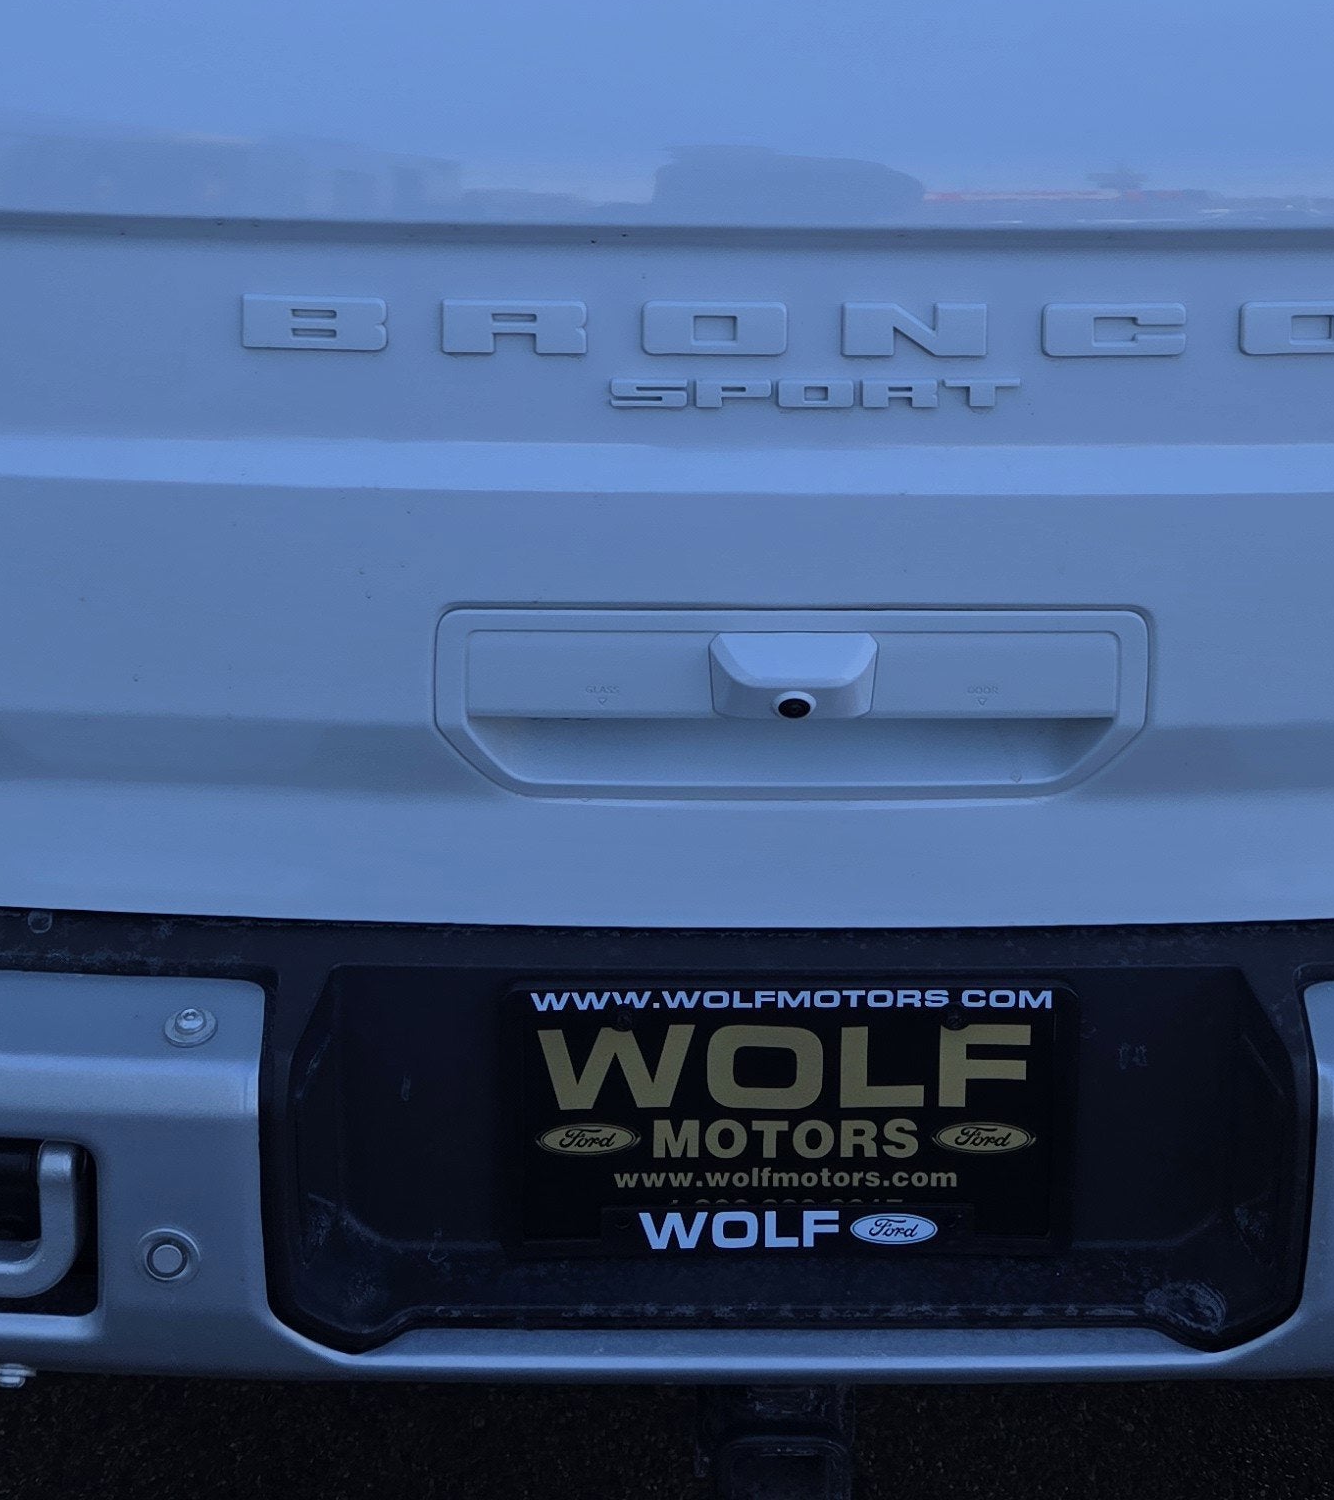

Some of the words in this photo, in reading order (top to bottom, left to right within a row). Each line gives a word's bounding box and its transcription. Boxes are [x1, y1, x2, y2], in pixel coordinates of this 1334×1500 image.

[609, 377, 1022, 408] SPORT
[536, 1024, 1032, 1111] WOLF
[558, 1126, 617, 1150] Ford
[652, 1117, 919, 1159] MOTORS
[951, 1125, 1012, 1149] Ford
[613, 1167, 958, 1189] www.wolfmotors.com
[638, 1210, 840, 1250] WOLF
[867, 1218, 920, 1239] Ford
